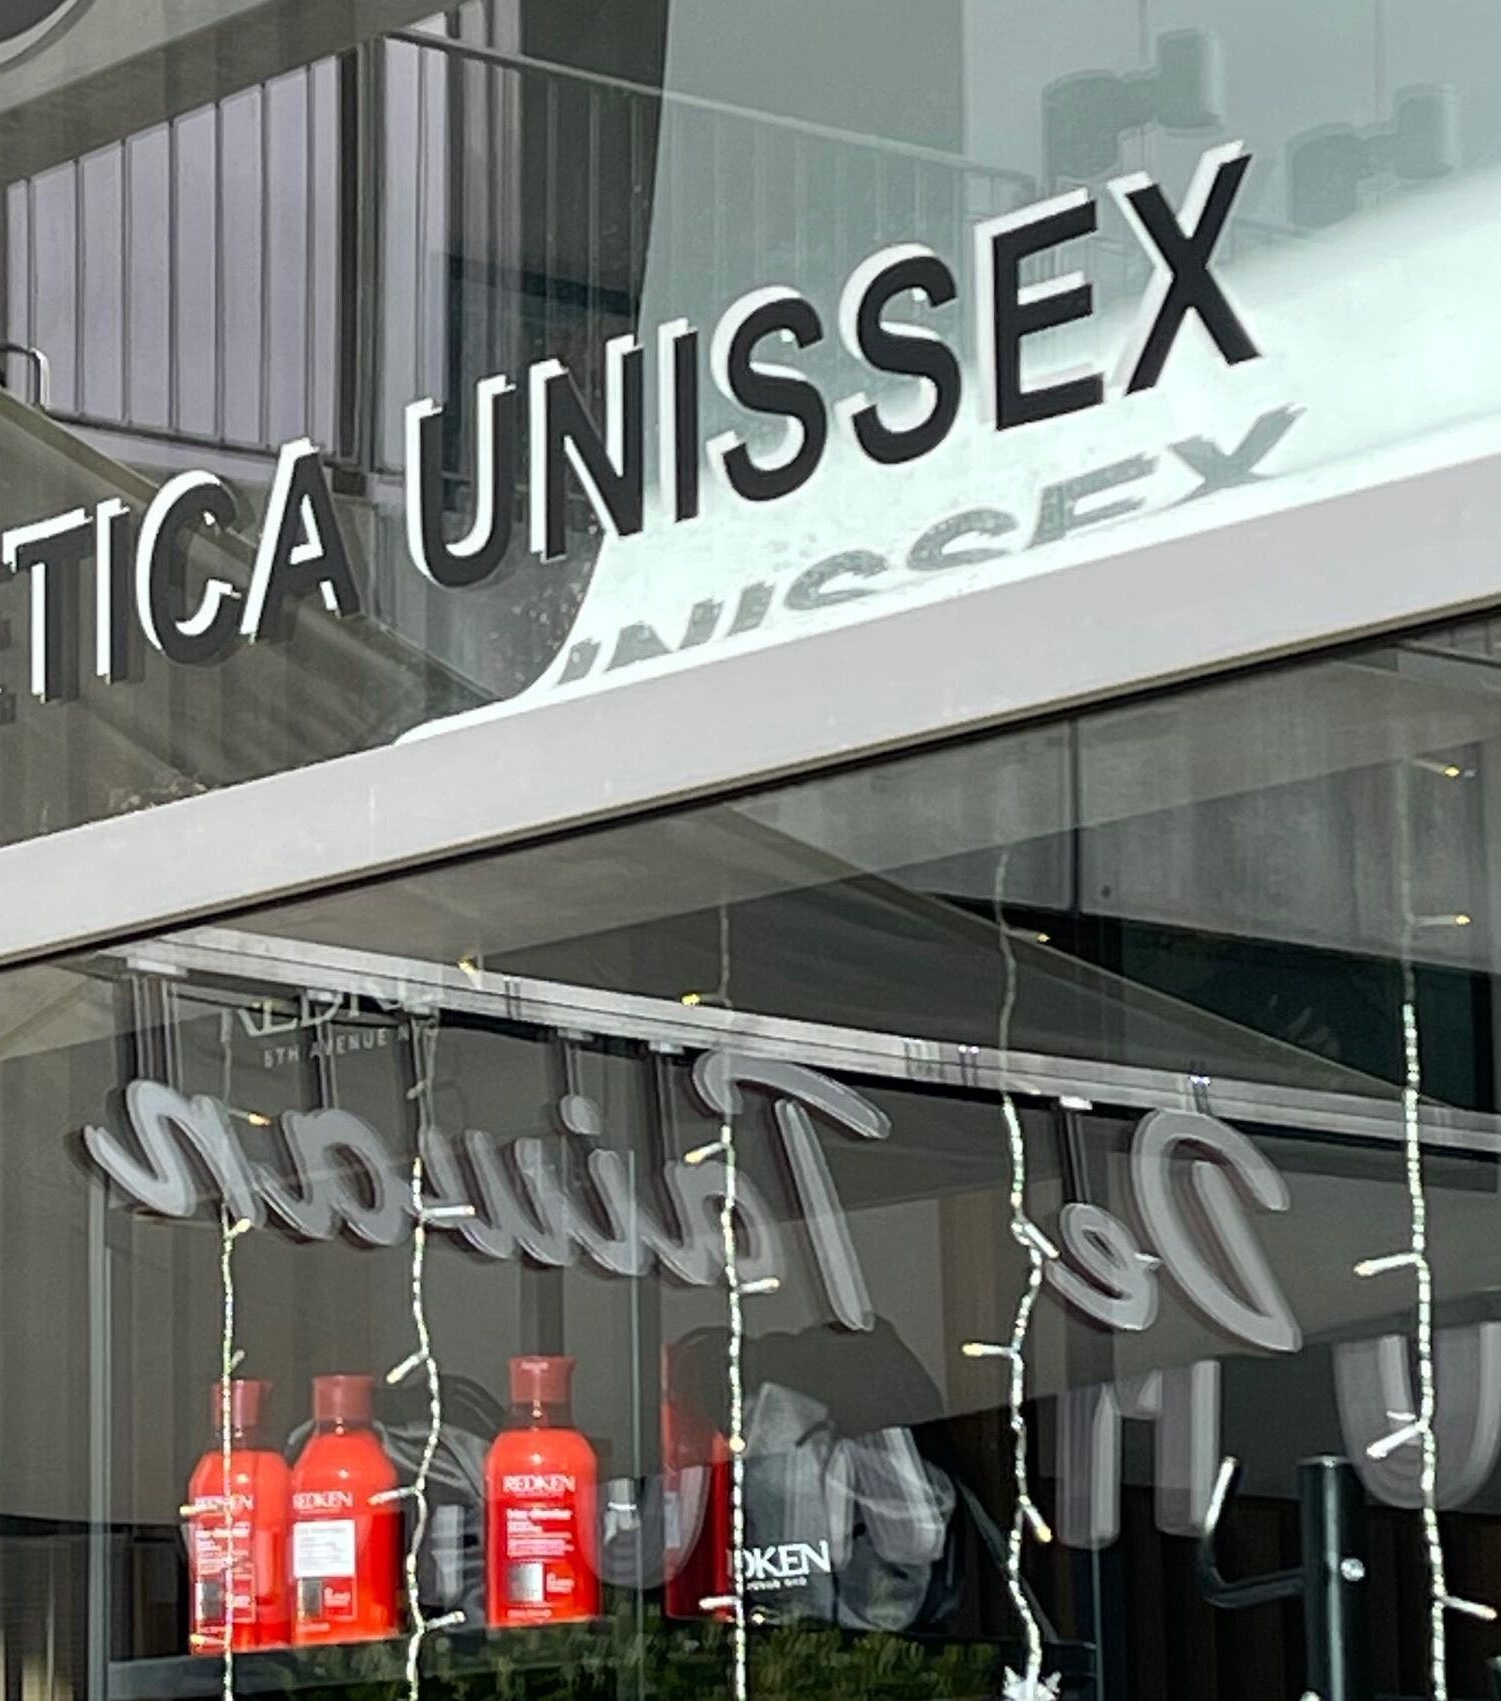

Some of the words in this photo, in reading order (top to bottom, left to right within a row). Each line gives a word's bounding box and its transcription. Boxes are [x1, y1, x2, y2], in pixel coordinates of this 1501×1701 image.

[404, 141, 1262, 588] UNISSEX
[503, 1475, 576, 1493] REDKEN
[293, 1491, 353, 1509] REDKEN
[726, 1539, 832, 1579] DKEN
